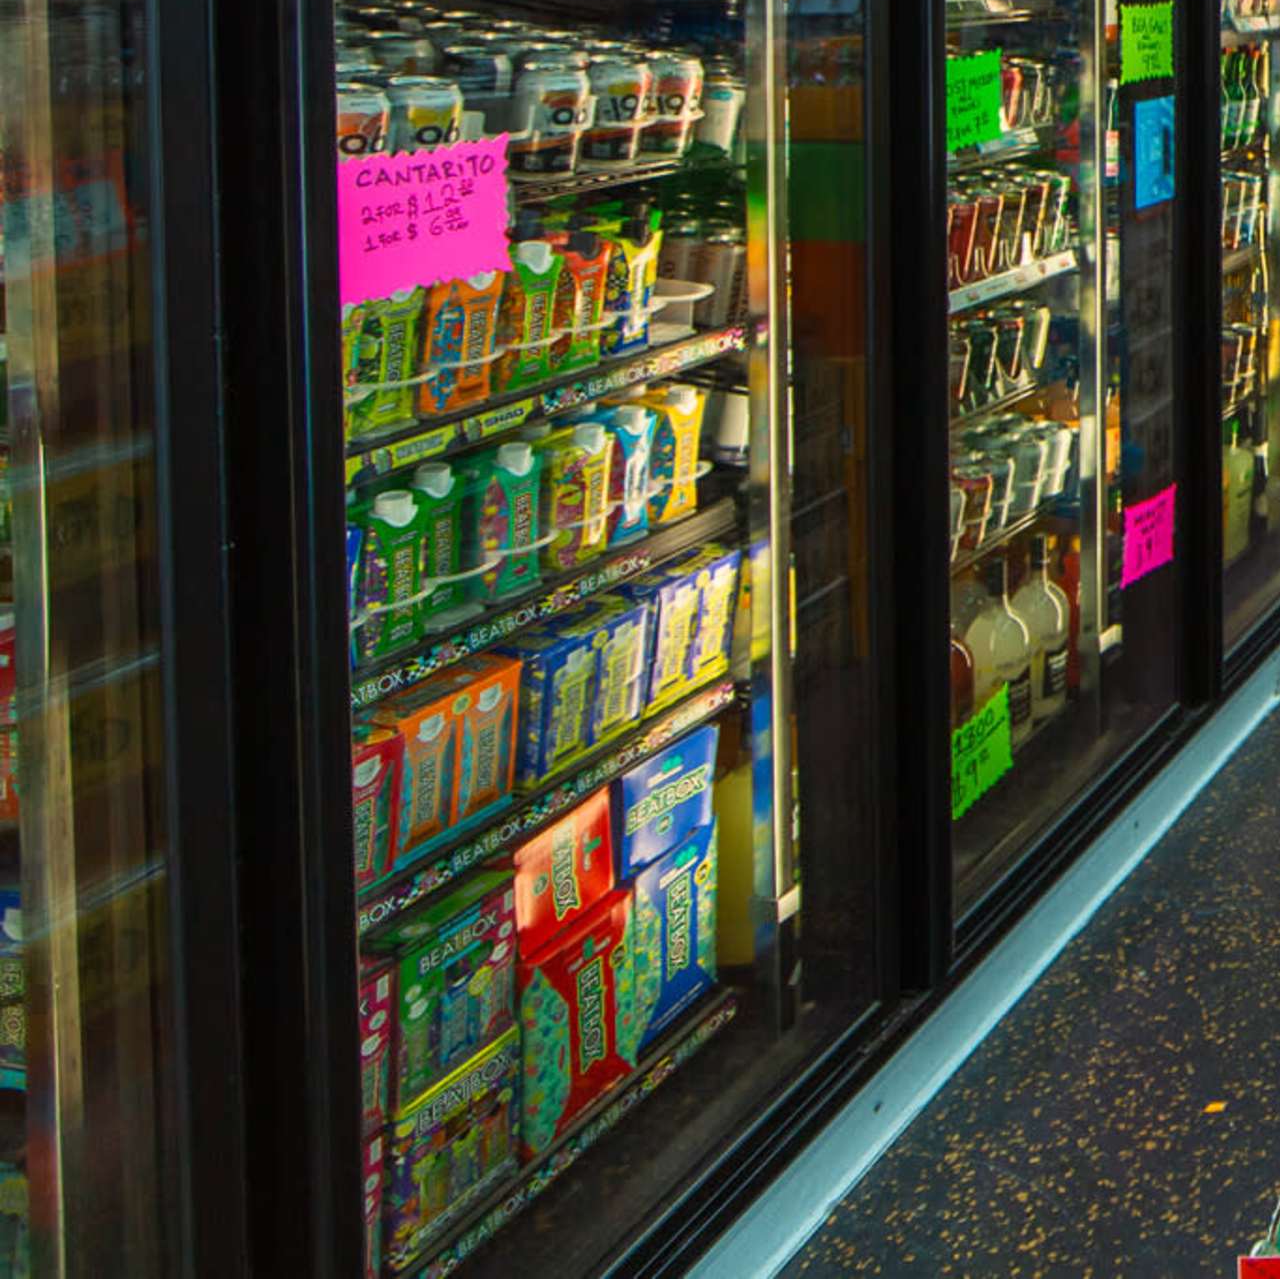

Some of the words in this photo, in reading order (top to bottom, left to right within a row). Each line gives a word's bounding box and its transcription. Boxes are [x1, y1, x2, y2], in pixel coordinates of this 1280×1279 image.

[580, 556, 639, 596] BEATBOX
[467, 604, 538, 651] BEATBOX
[350, 669, 405, 706] ATBOX
[628, 773, 706, 832] BEATBOX
[452, 818, 524, 872] BEATBOX
[418, 909, 498, 972] BEATBOX
[667, 881, 688, 967] BEATBOX
[581, 963, 602, 1059] BEATBOX
